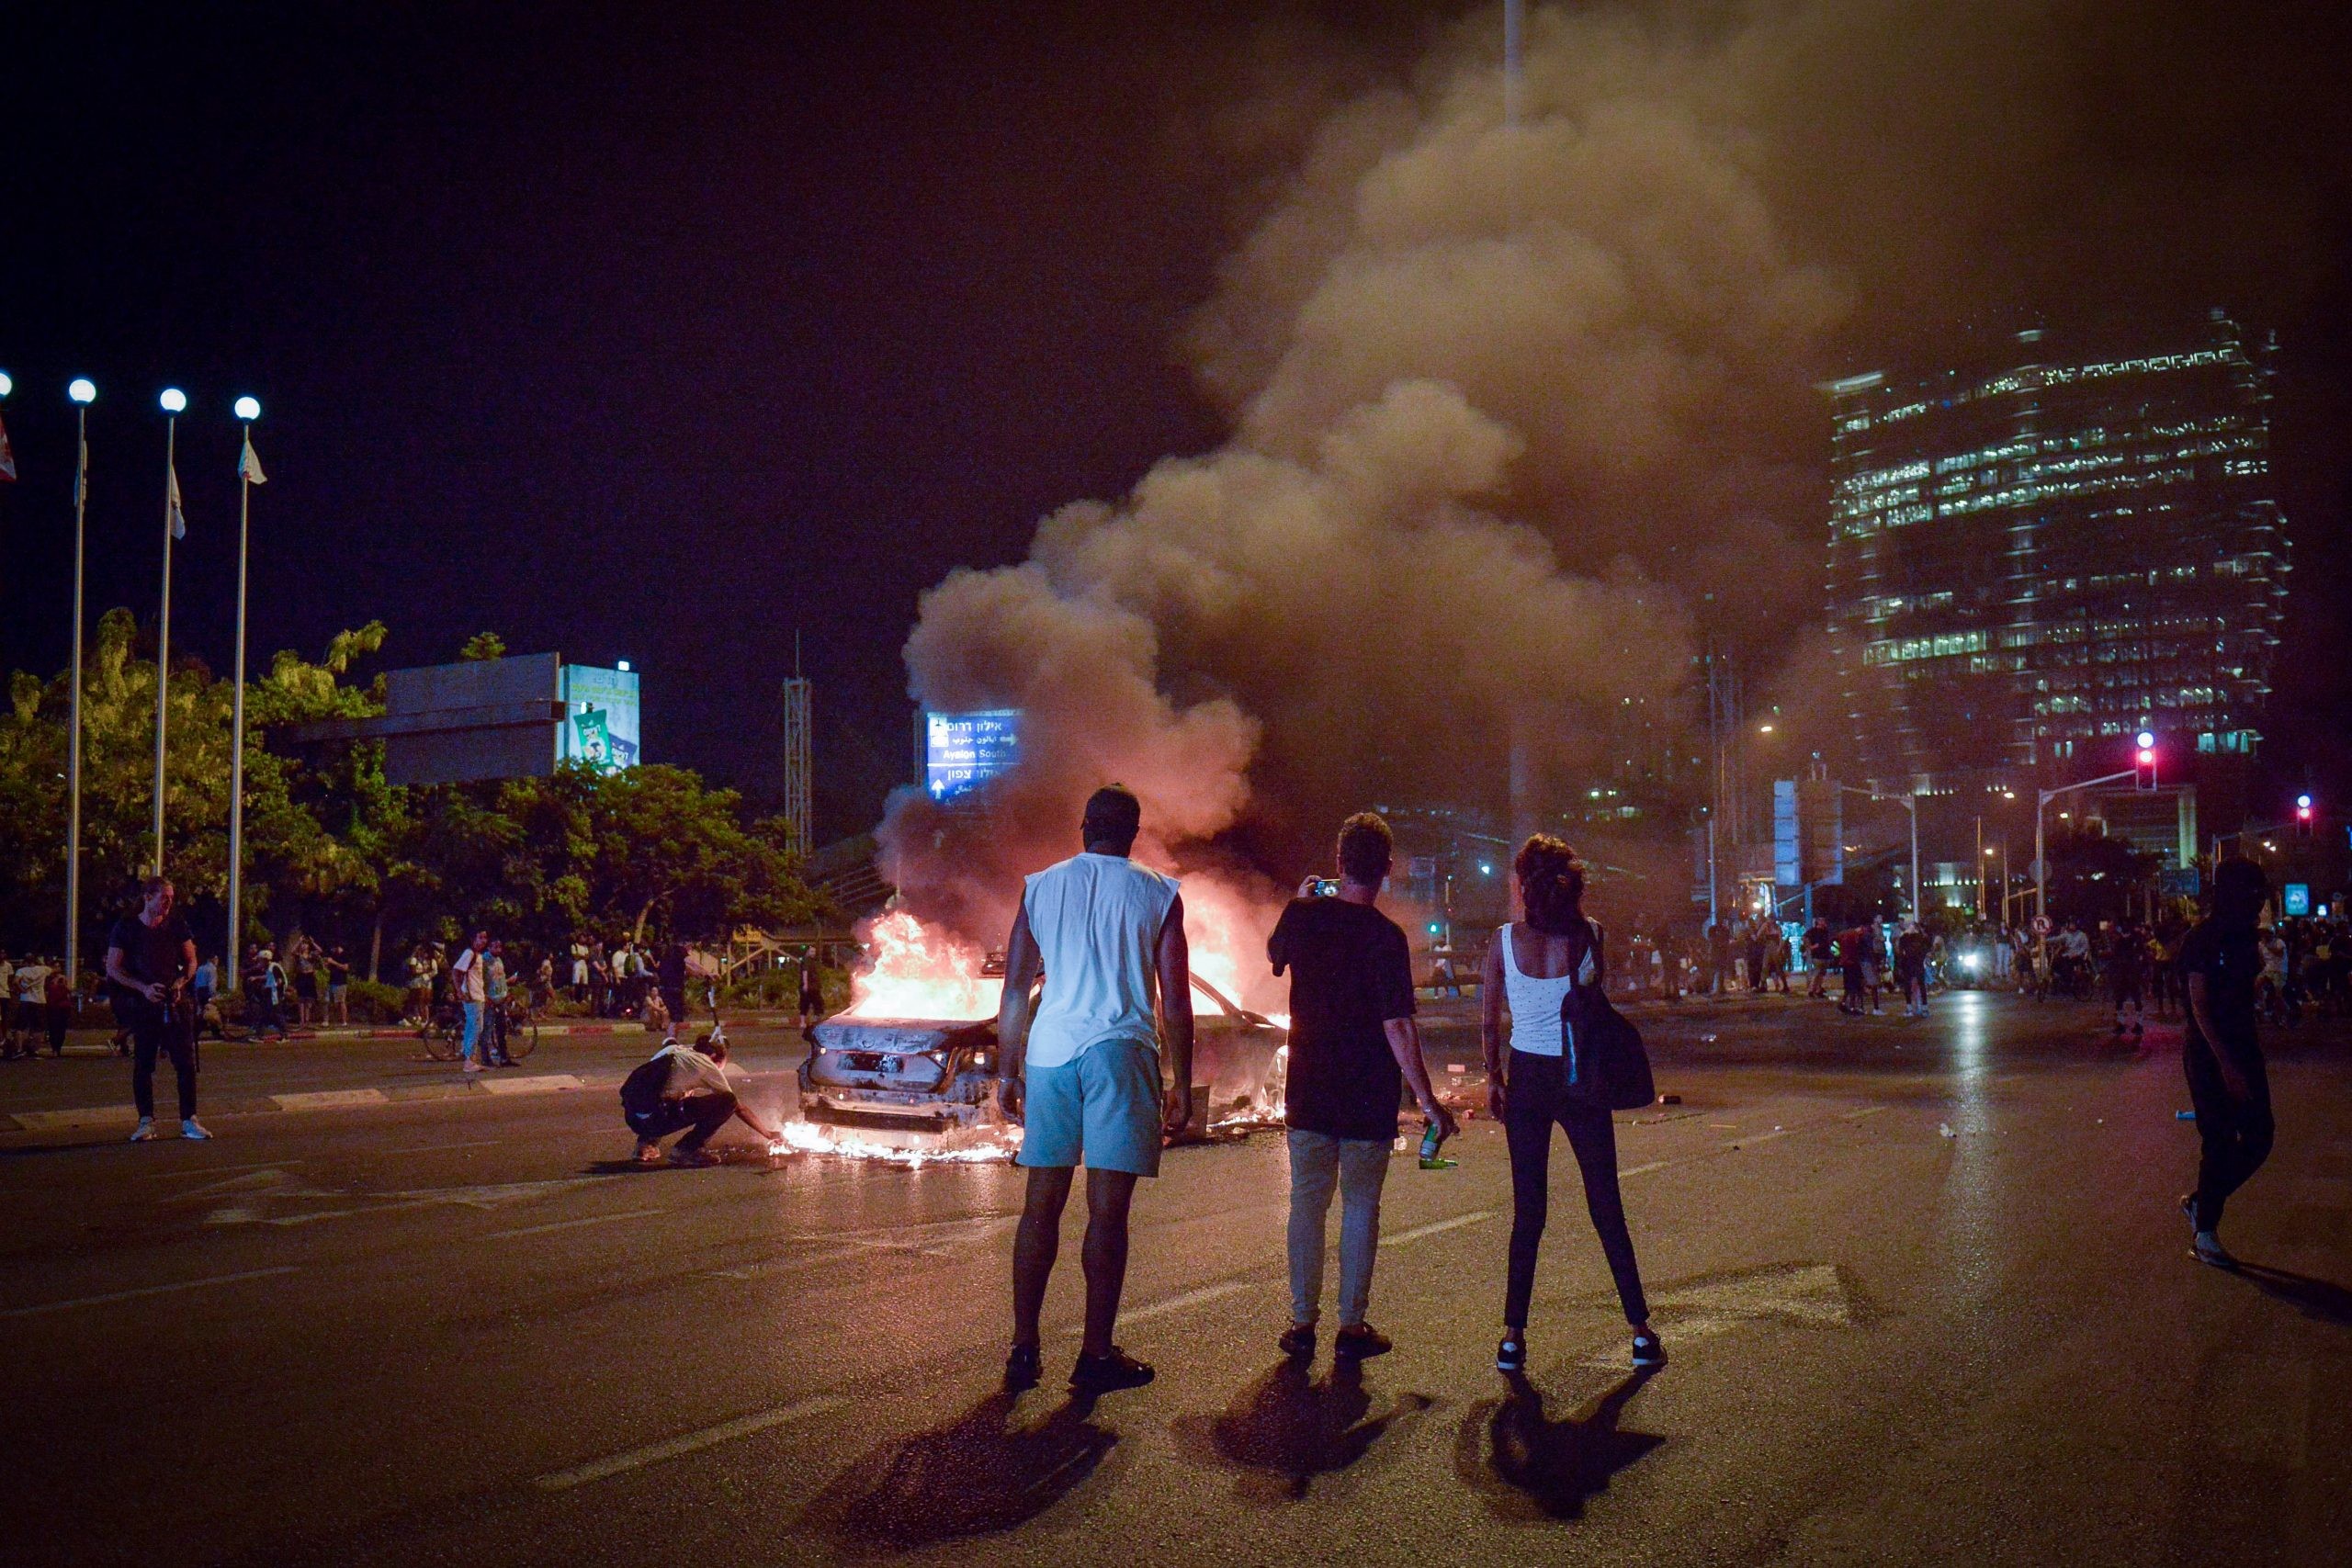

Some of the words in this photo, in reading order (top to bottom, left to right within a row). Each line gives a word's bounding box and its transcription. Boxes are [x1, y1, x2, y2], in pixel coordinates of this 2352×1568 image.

[947, 722, 972, 732] דרום
[977, 720, 1002, 733] אילון
[943, 750, 976, 761] Ayalon
[978, 749, 1007, 758] South
[947, 769, 972, 781] צפון
